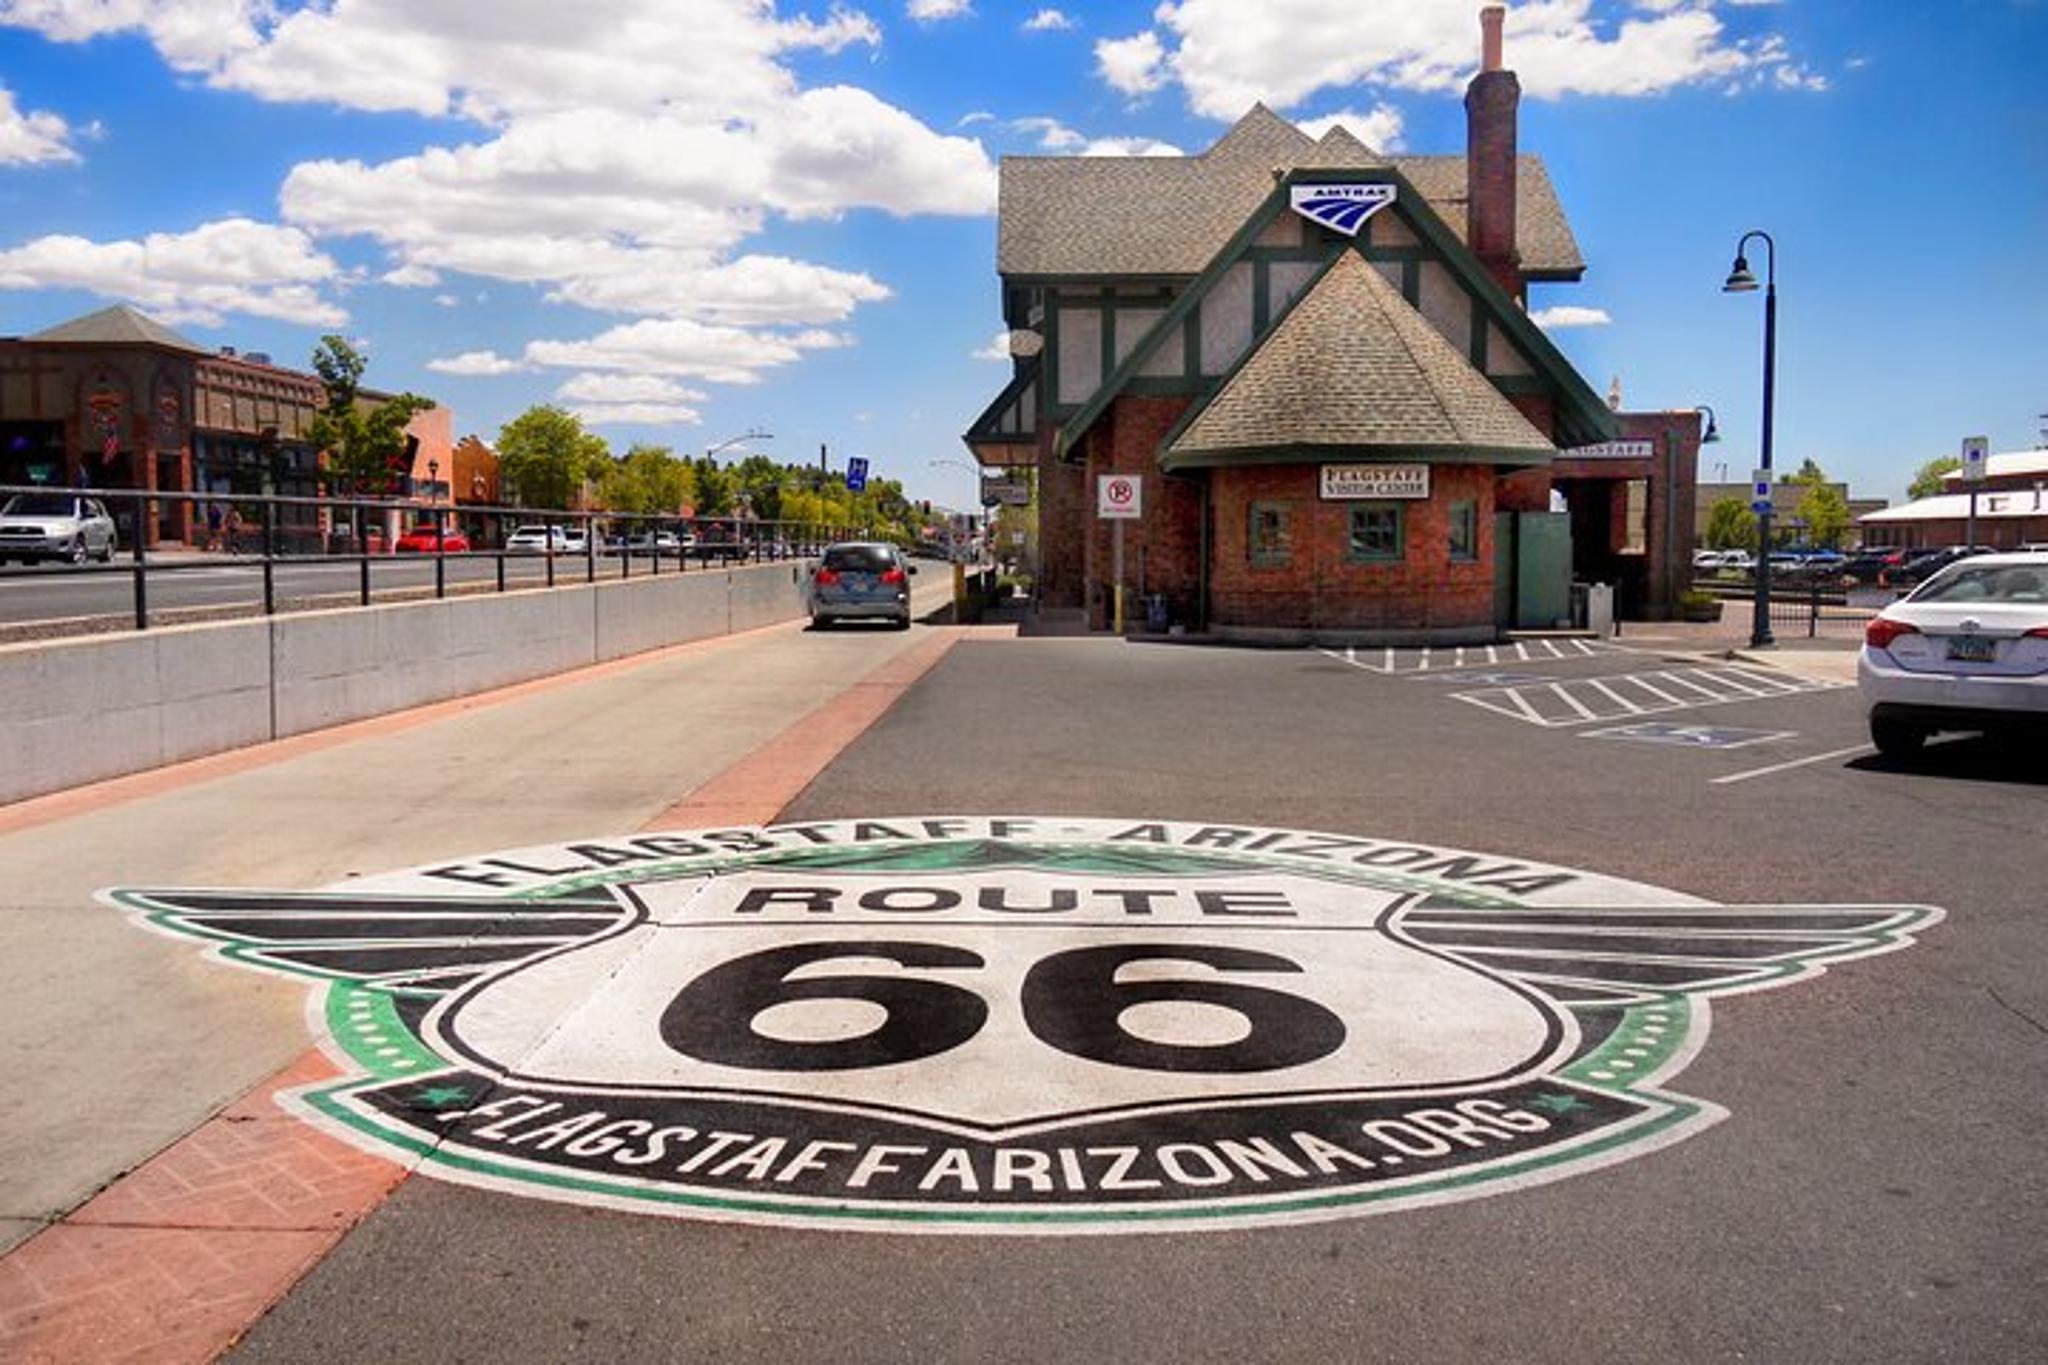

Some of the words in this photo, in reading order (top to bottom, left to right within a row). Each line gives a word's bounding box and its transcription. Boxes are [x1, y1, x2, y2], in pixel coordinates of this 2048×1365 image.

[1325, 468, 1422, 481] FLAGSTAFF
[422, 820, 1035, 888] FLAGSTAFF
[1108, 822, 1578, 895] ARIZONA
[735, 886, 1298, 917] ROUTE
[659, 940, 1347, 1072] 66
